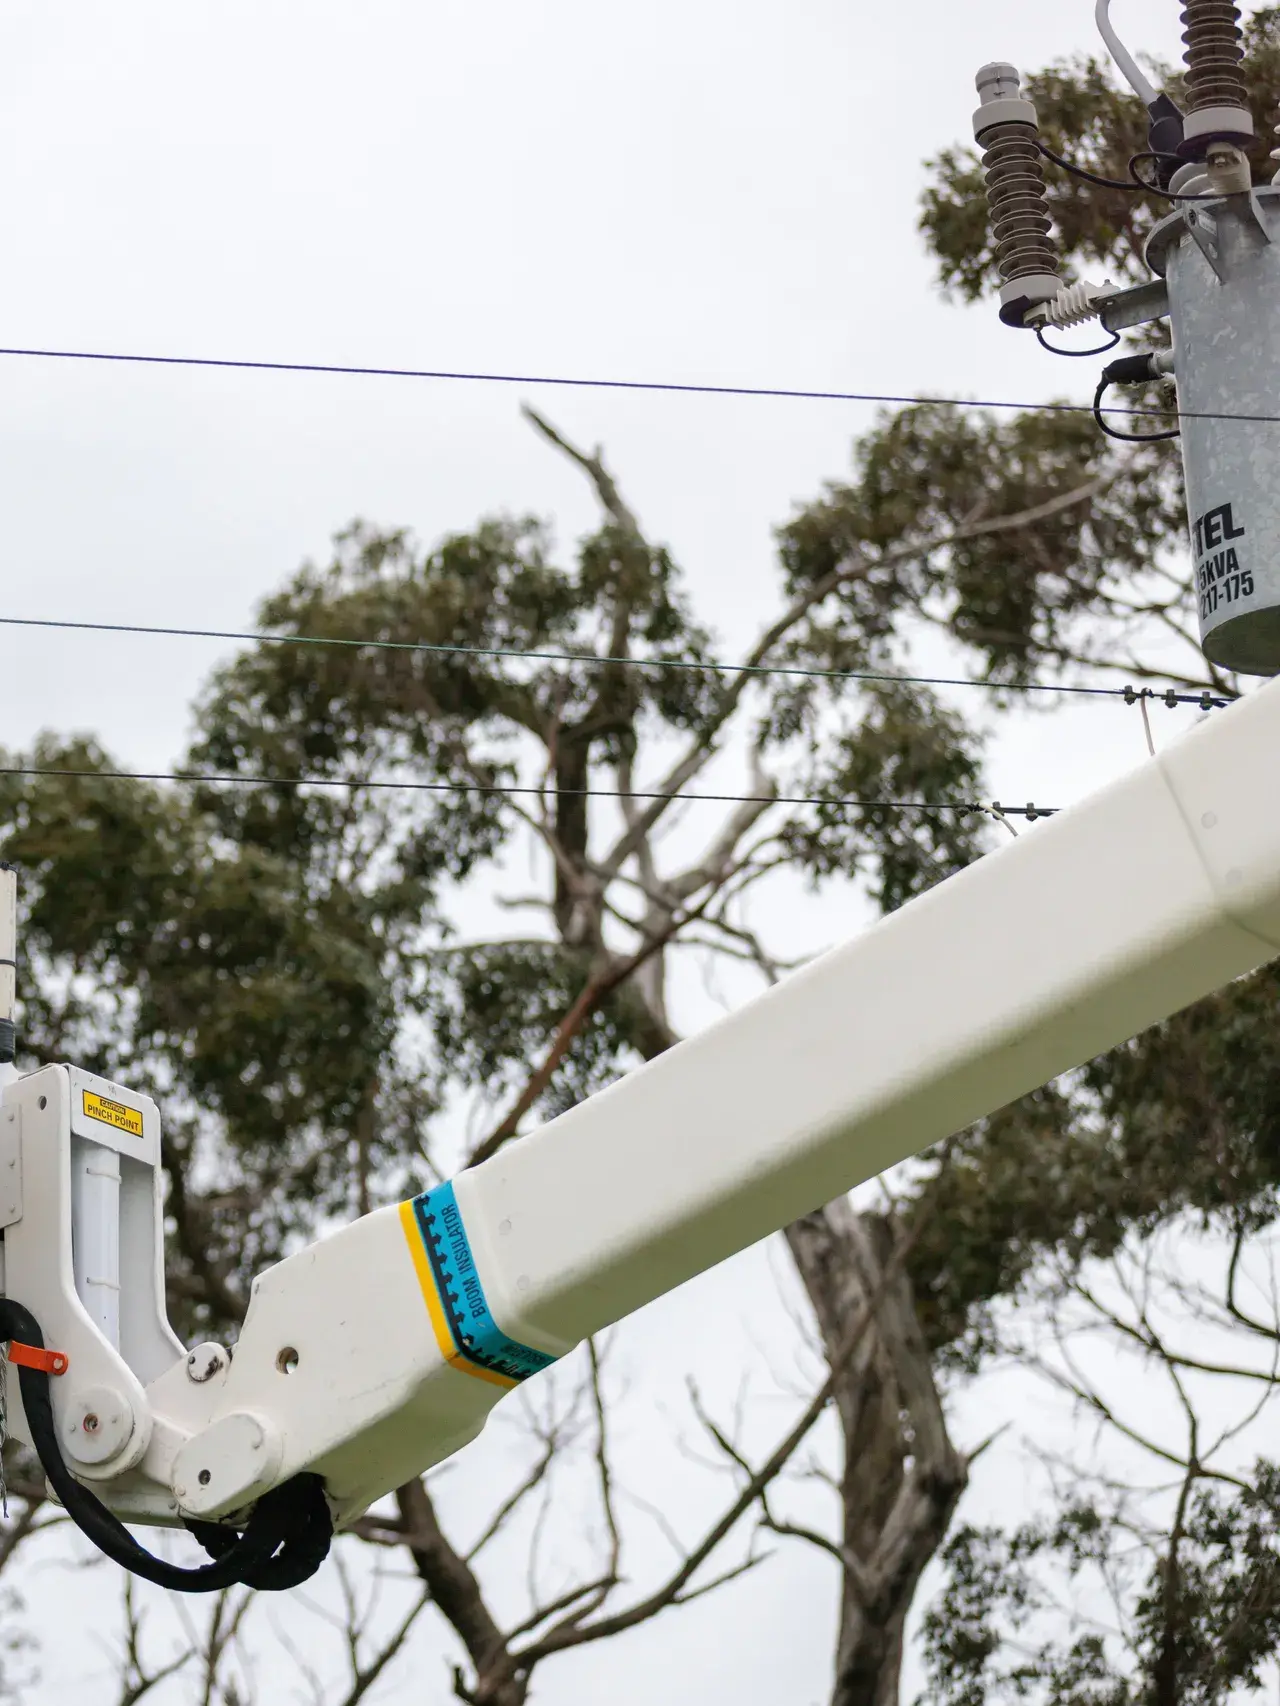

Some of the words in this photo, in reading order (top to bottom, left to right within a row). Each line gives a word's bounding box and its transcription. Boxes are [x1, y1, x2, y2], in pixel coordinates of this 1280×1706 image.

[1191, 502, 1245, 558] TEL
[1196, 547, 1240, 591] 5kVA
[87, 1104, 112, 1122] PINCH
[115, 1114, 139, 1132] POINT
[101, 1099, 125, 1114] CAUTION
[441, 1203, 473, 1275] INSULATOR
[461, 1279, 486, 1319] BOOM
